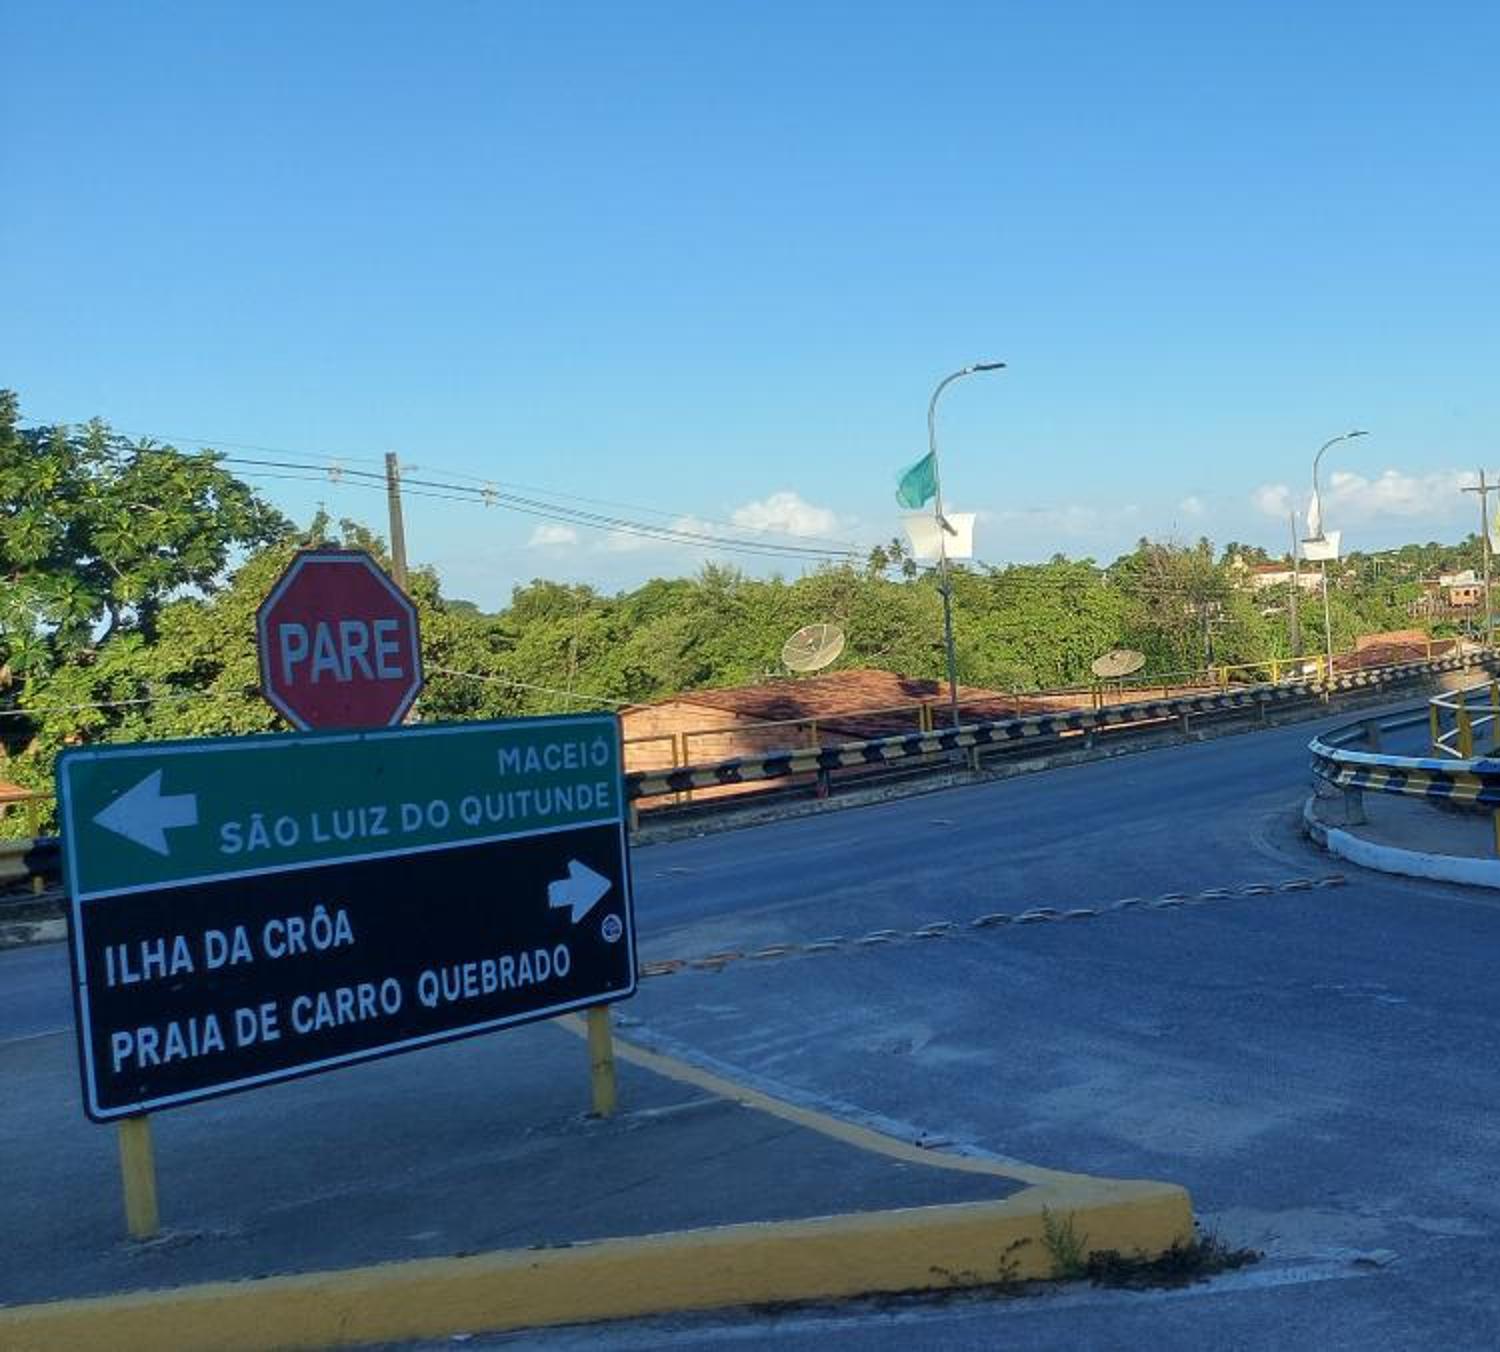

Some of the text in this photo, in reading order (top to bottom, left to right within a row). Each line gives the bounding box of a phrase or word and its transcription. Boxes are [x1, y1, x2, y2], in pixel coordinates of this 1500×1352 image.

[279, 619, 402, 686] PARE
[499, 736, 609, 775] MACEIÓ
[220, 782, 609, 854] SÃO LUIZ DO QUITUNDE
[105, 905, 355, 987] ILHA DA CRÔA
[112, 943, 572, 1073] PRAIA DE CARRO QUEBRADO
